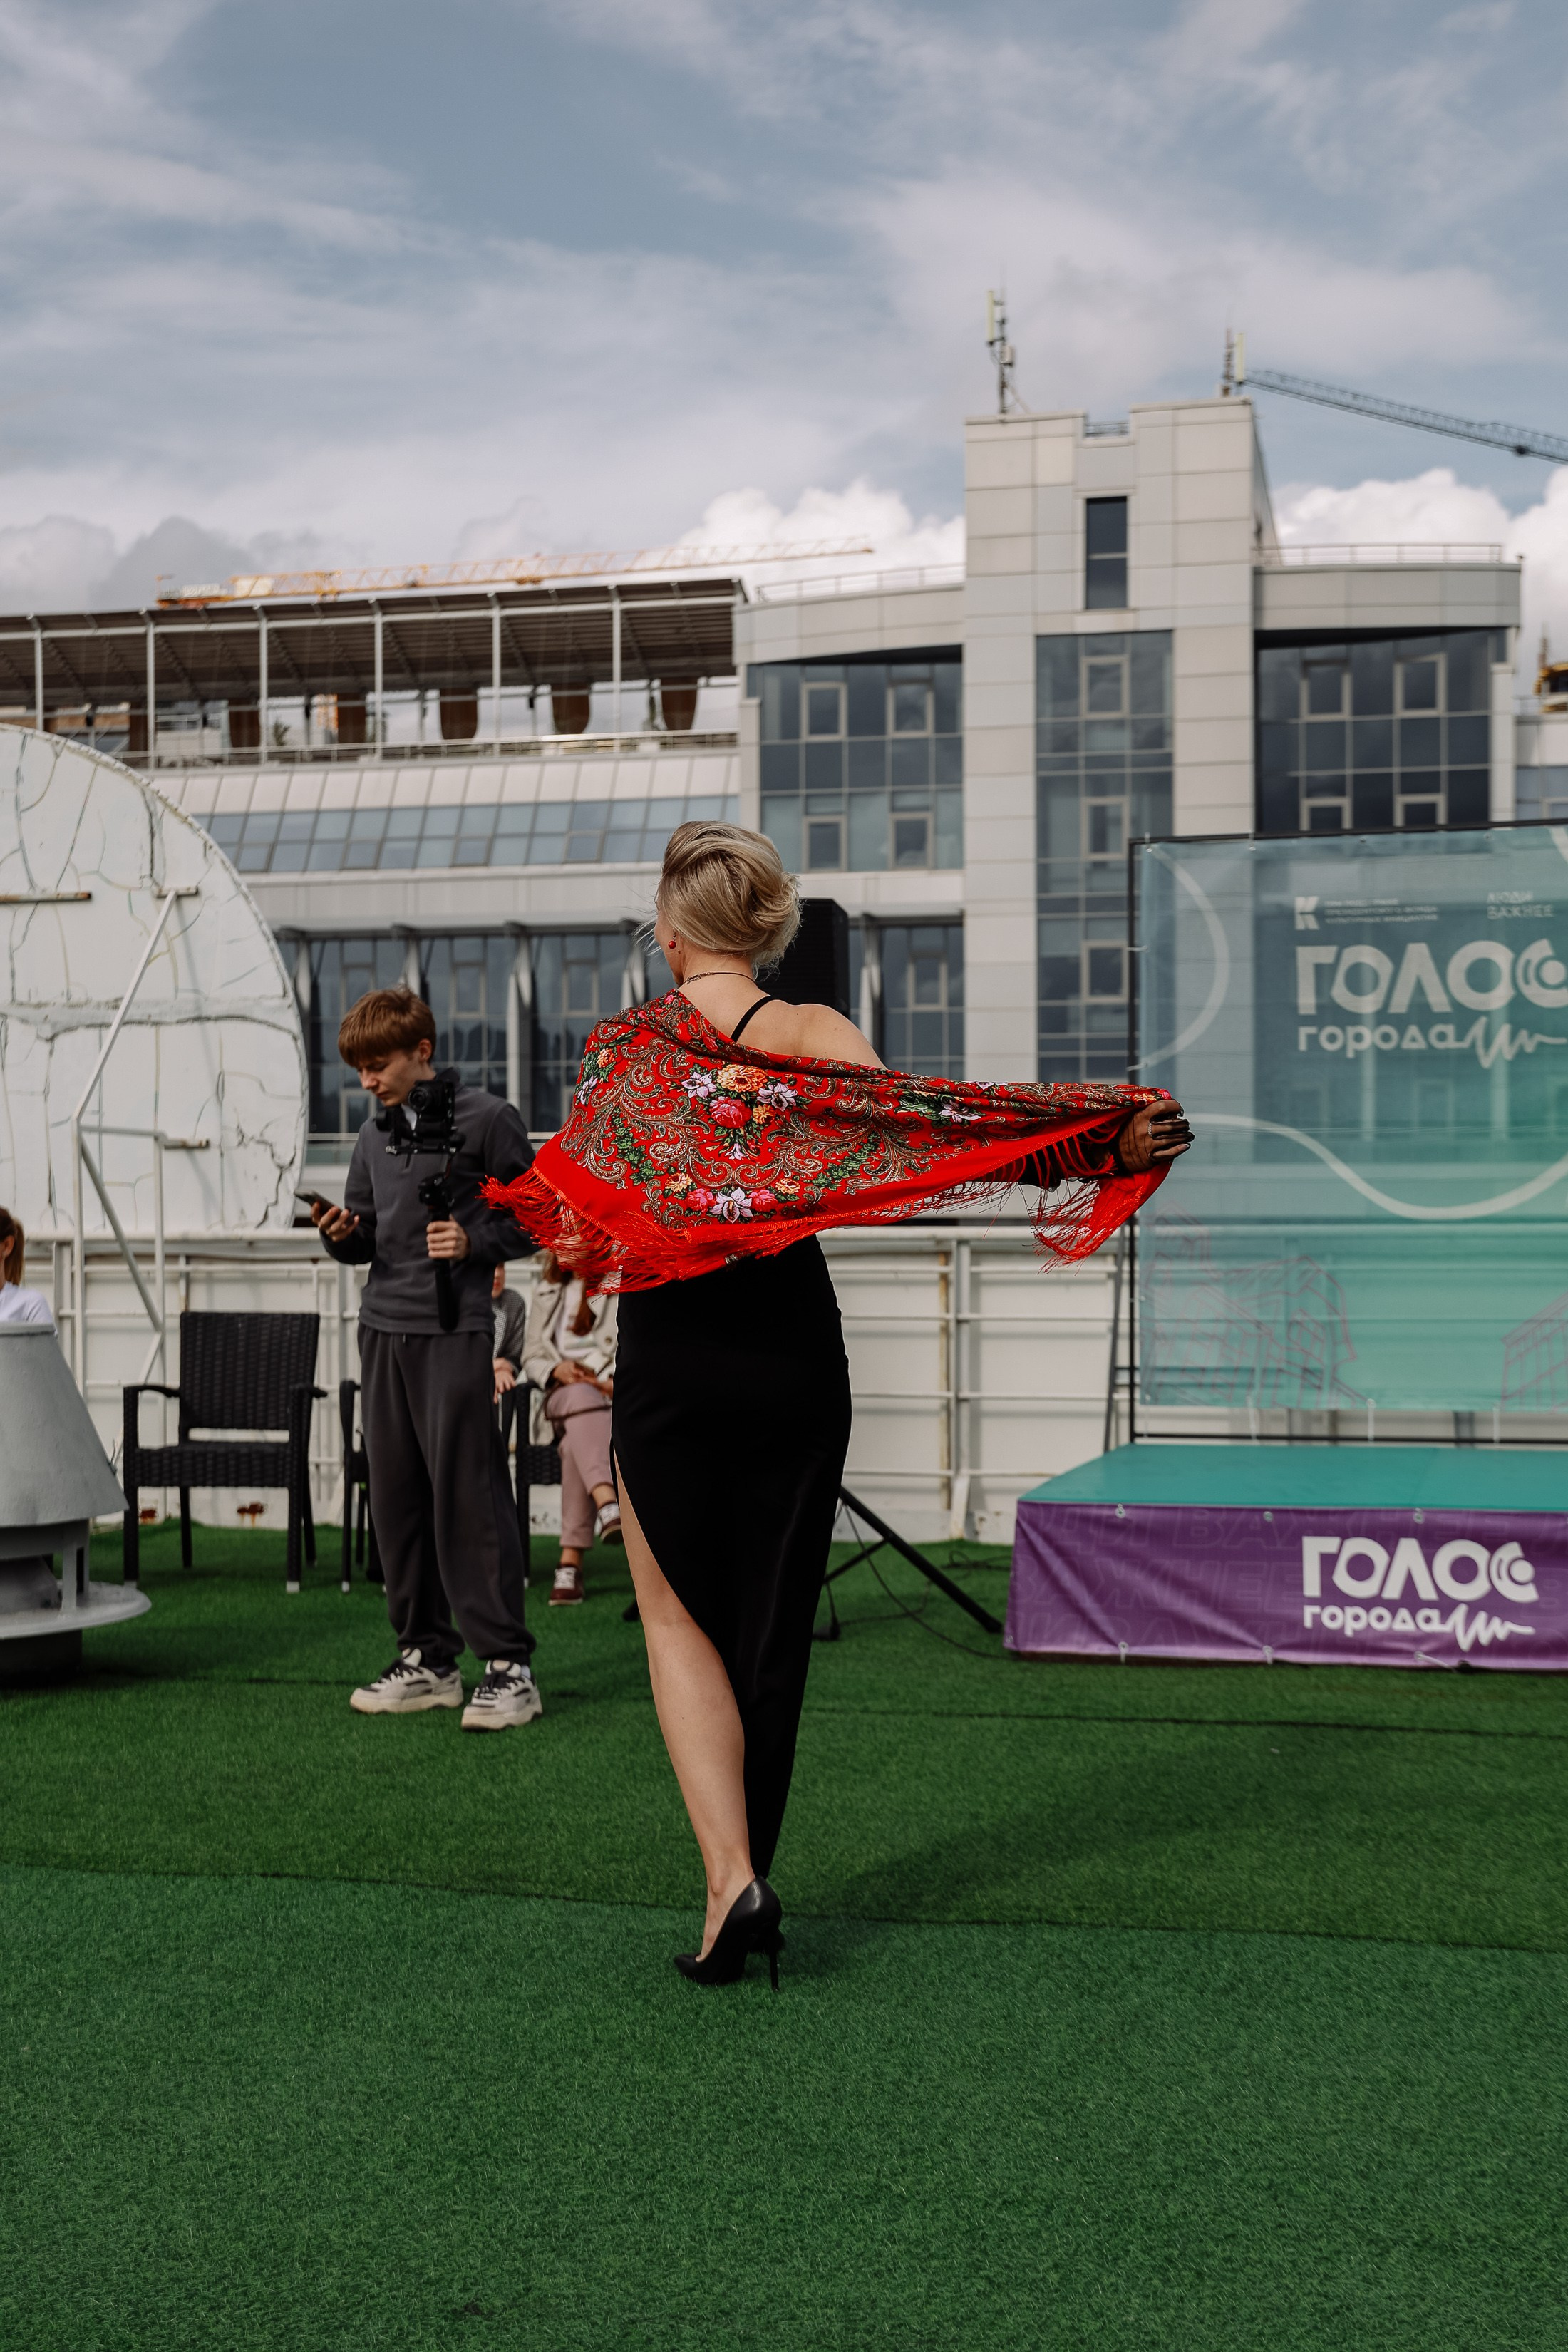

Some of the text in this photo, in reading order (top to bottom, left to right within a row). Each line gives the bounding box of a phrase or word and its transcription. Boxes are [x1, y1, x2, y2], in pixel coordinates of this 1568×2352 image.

[1296, 939, 1568, 1015] ГОЛОС
[1298, 1024, 1458, 1058] города
[1301, 1535, 1539, 1603] ГОЛОС
[1303, 1604, 1443, 1637] города
